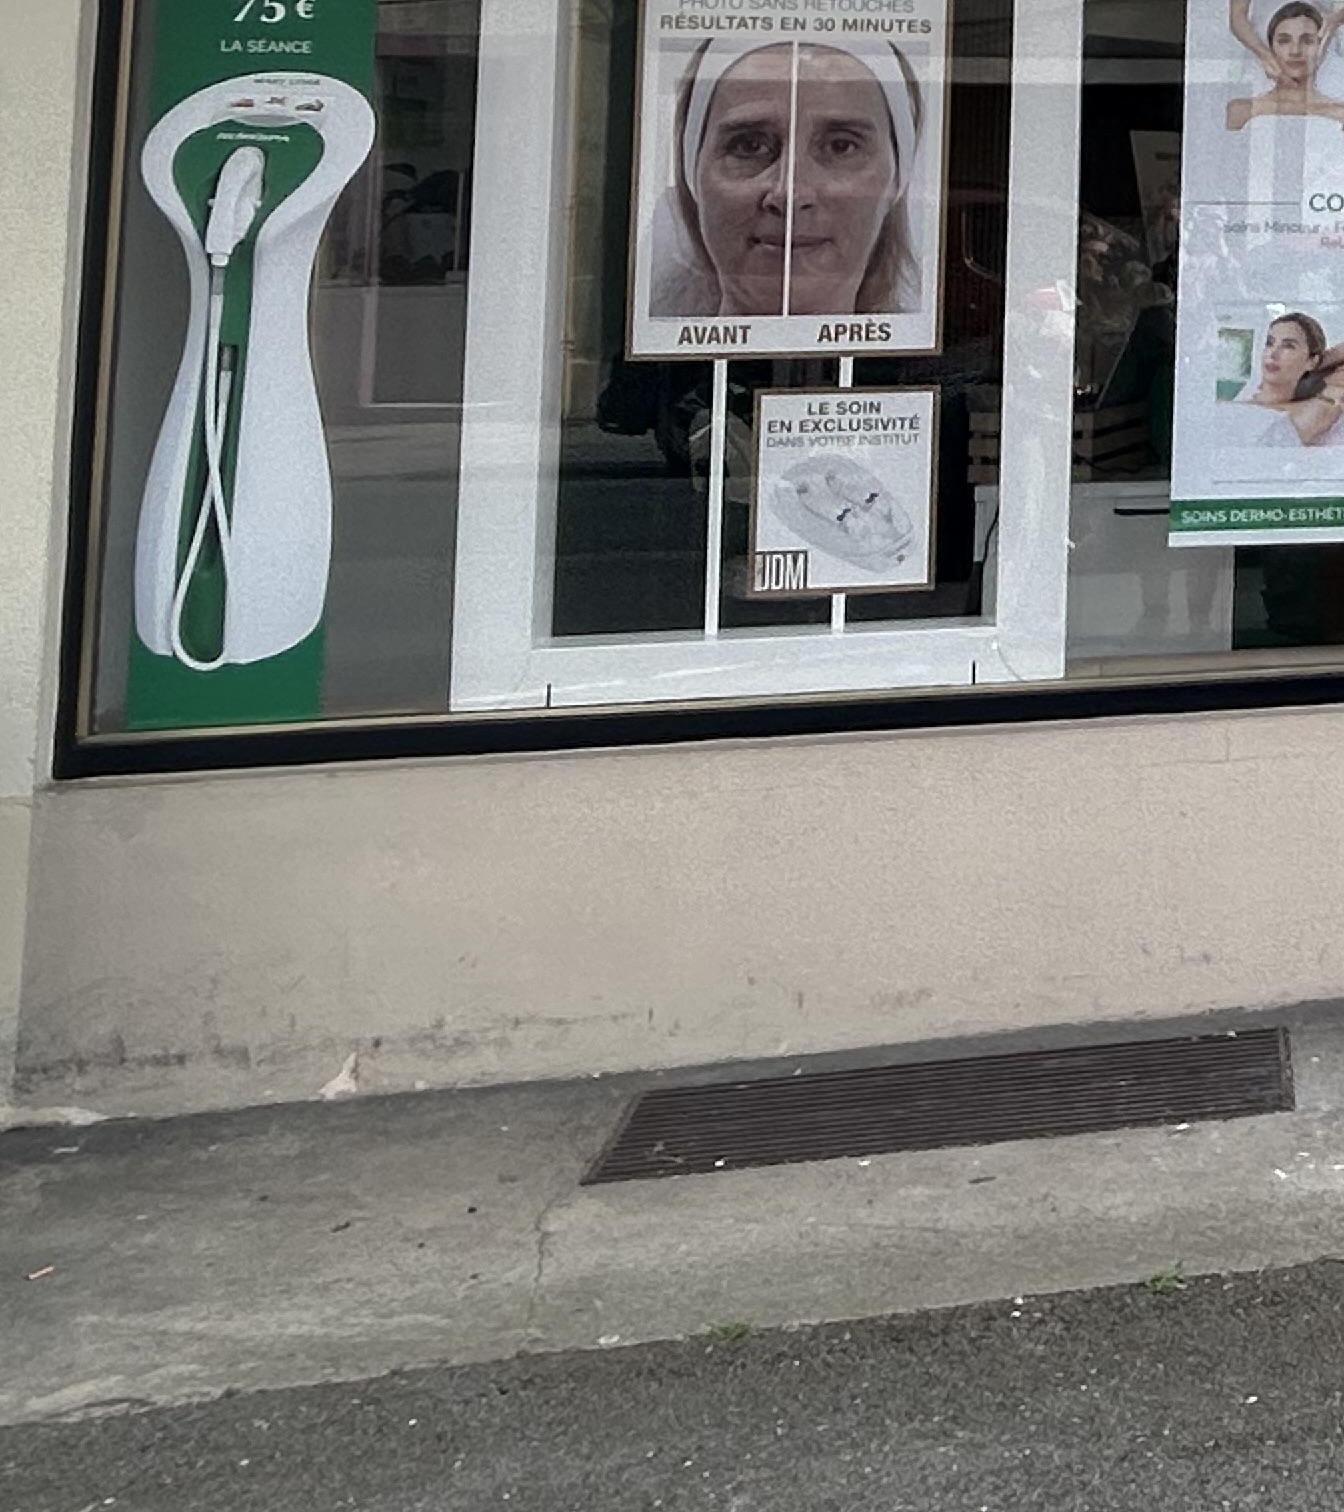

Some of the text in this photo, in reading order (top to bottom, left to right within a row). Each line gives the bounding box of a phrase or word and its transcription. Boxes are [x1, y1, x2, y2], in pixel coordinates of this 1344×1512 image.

[660, 11, 932, 33] RÉSULTATS EN 30 MINUTES
[220, 39, 312, 54] LA SÉANCE
[678, 318, 892, 346] AVANT APRÈS
[807, 400, 882, 415] LE SOIN
[767, 413, 920, 433] EN EXCLUSIVITÉ
[766, 436, 805, 448] DANS
[1182, 509, 1227, 524] SOINS
